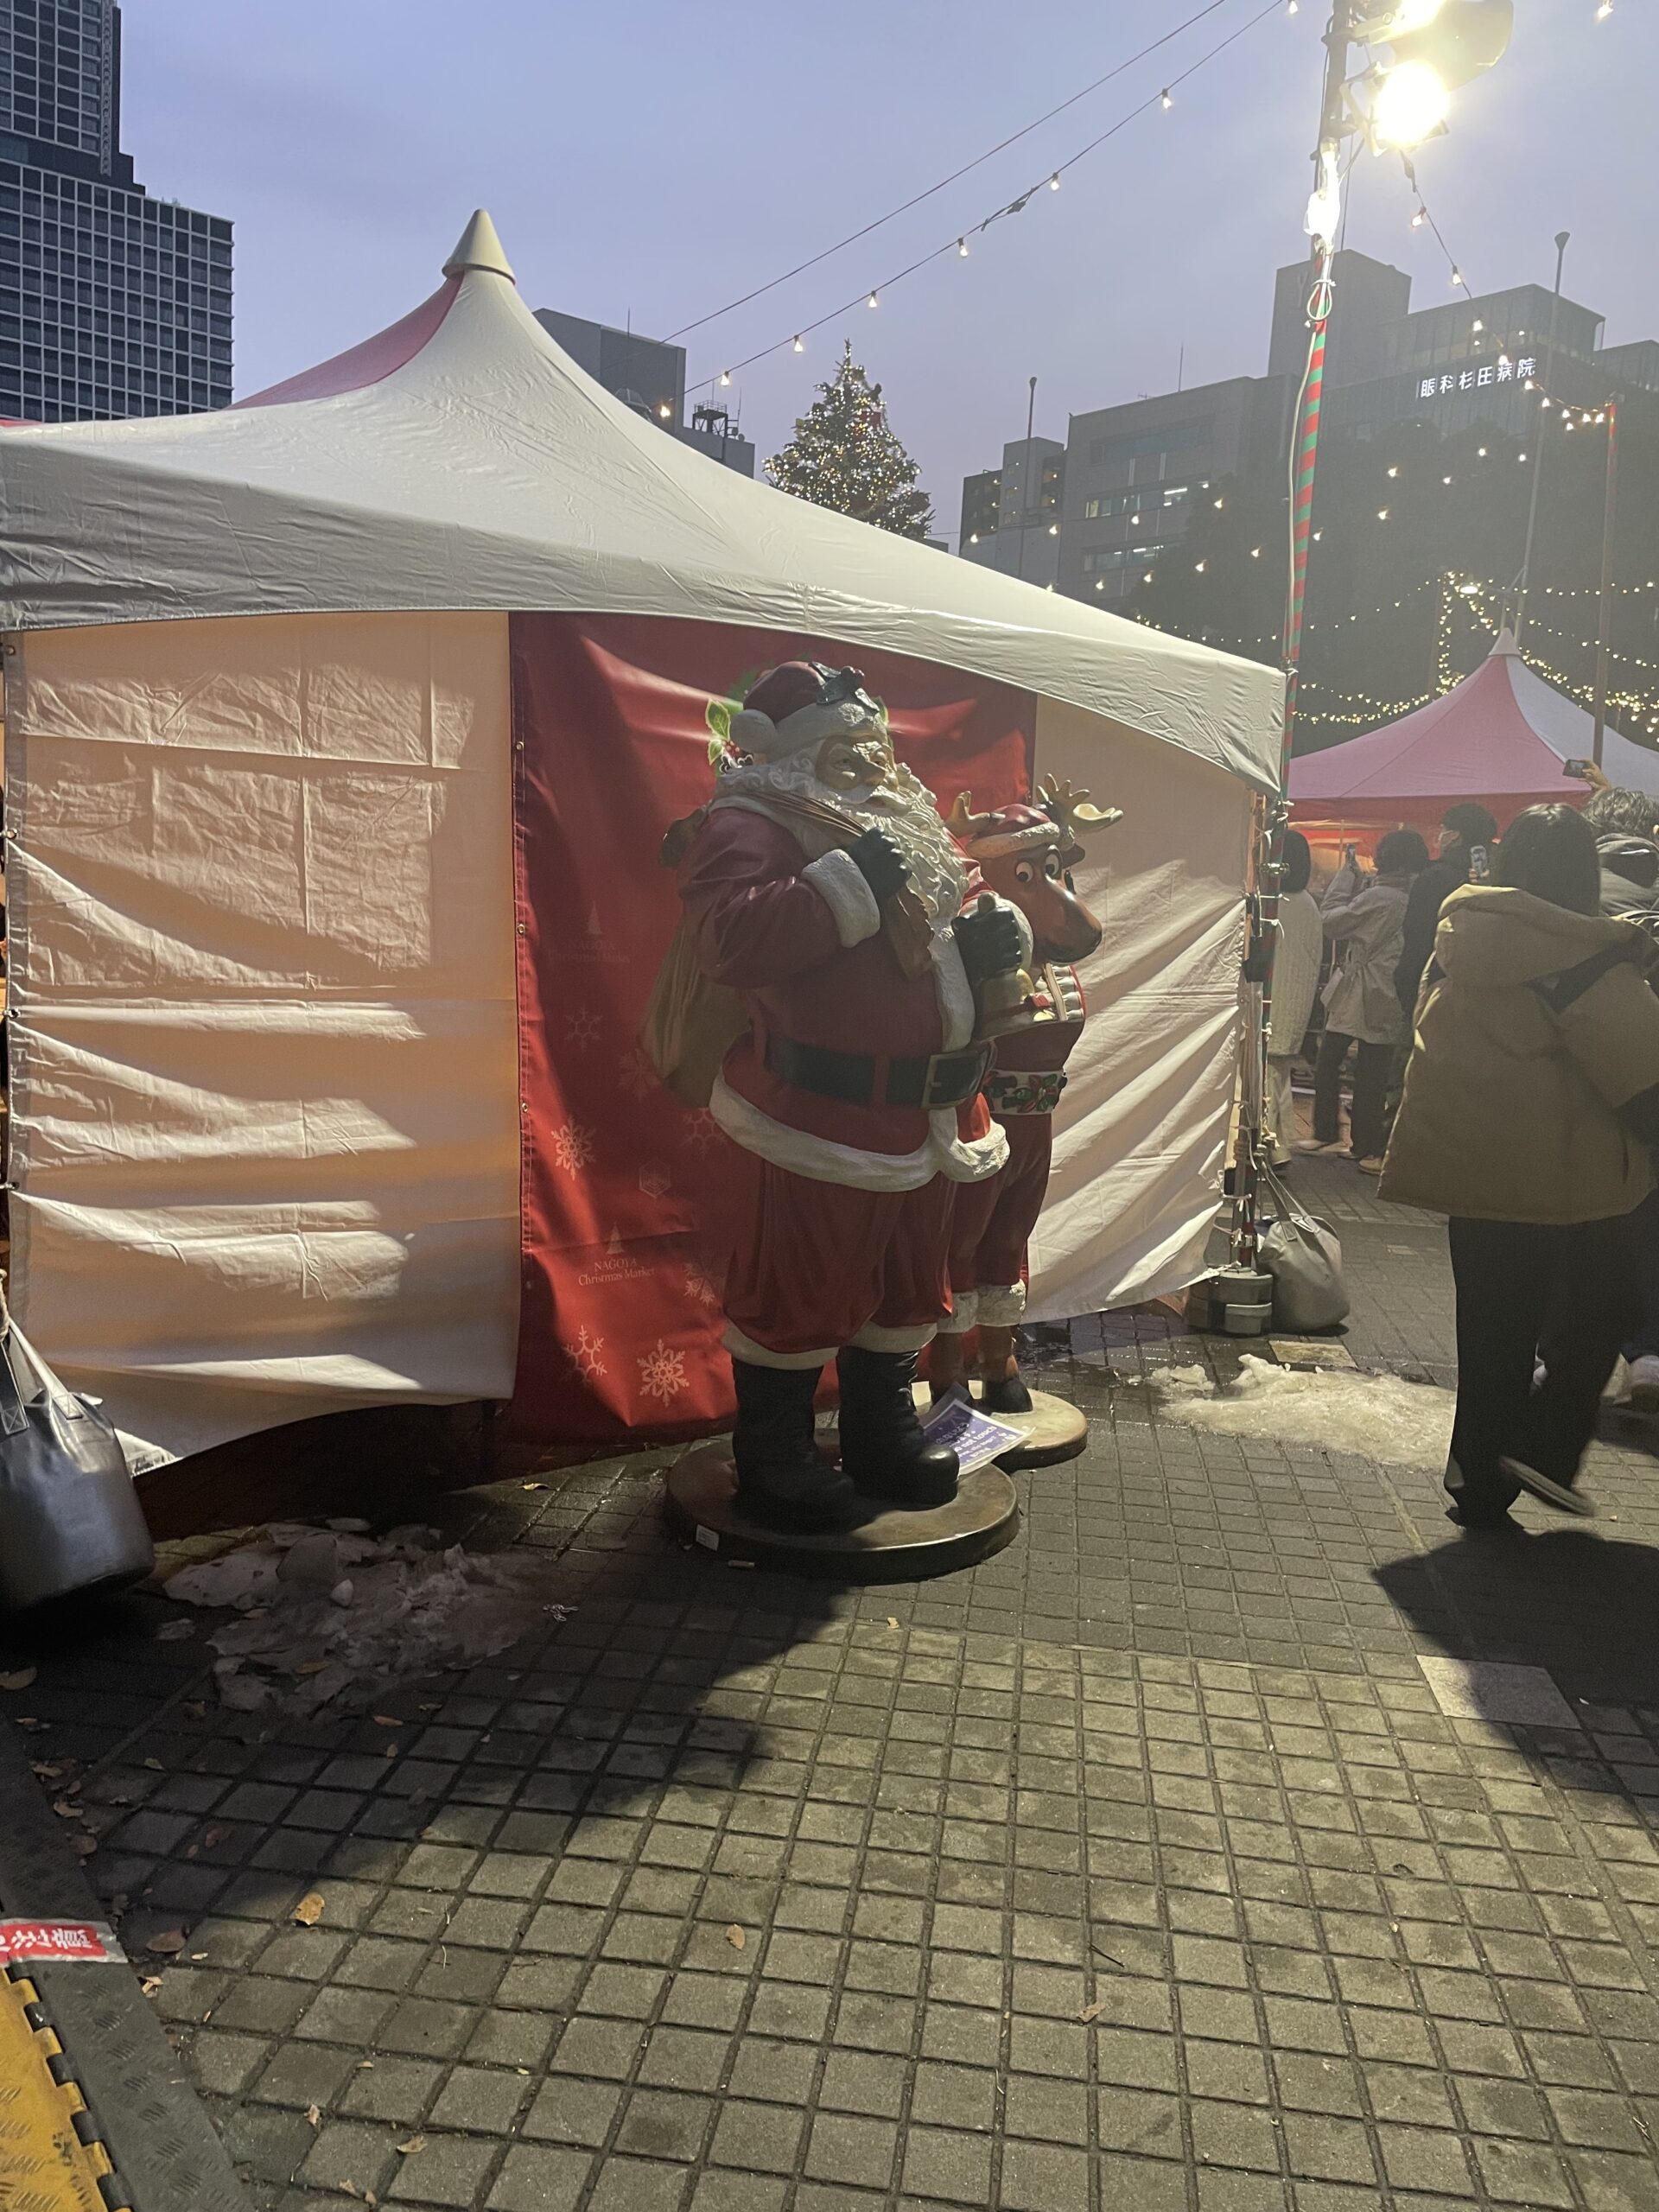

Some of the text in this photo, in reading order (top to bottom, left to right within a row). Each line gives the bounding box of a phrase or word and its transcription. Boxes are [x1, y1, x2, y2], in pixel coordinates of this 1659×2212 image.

[594, 1257, 638, 1273] NAGOYA
[578, 1266, 655, 1287] Christmas Market
[973, 1426, 998, 1440] touch
[0, 1927, 93, 1953] 注意
